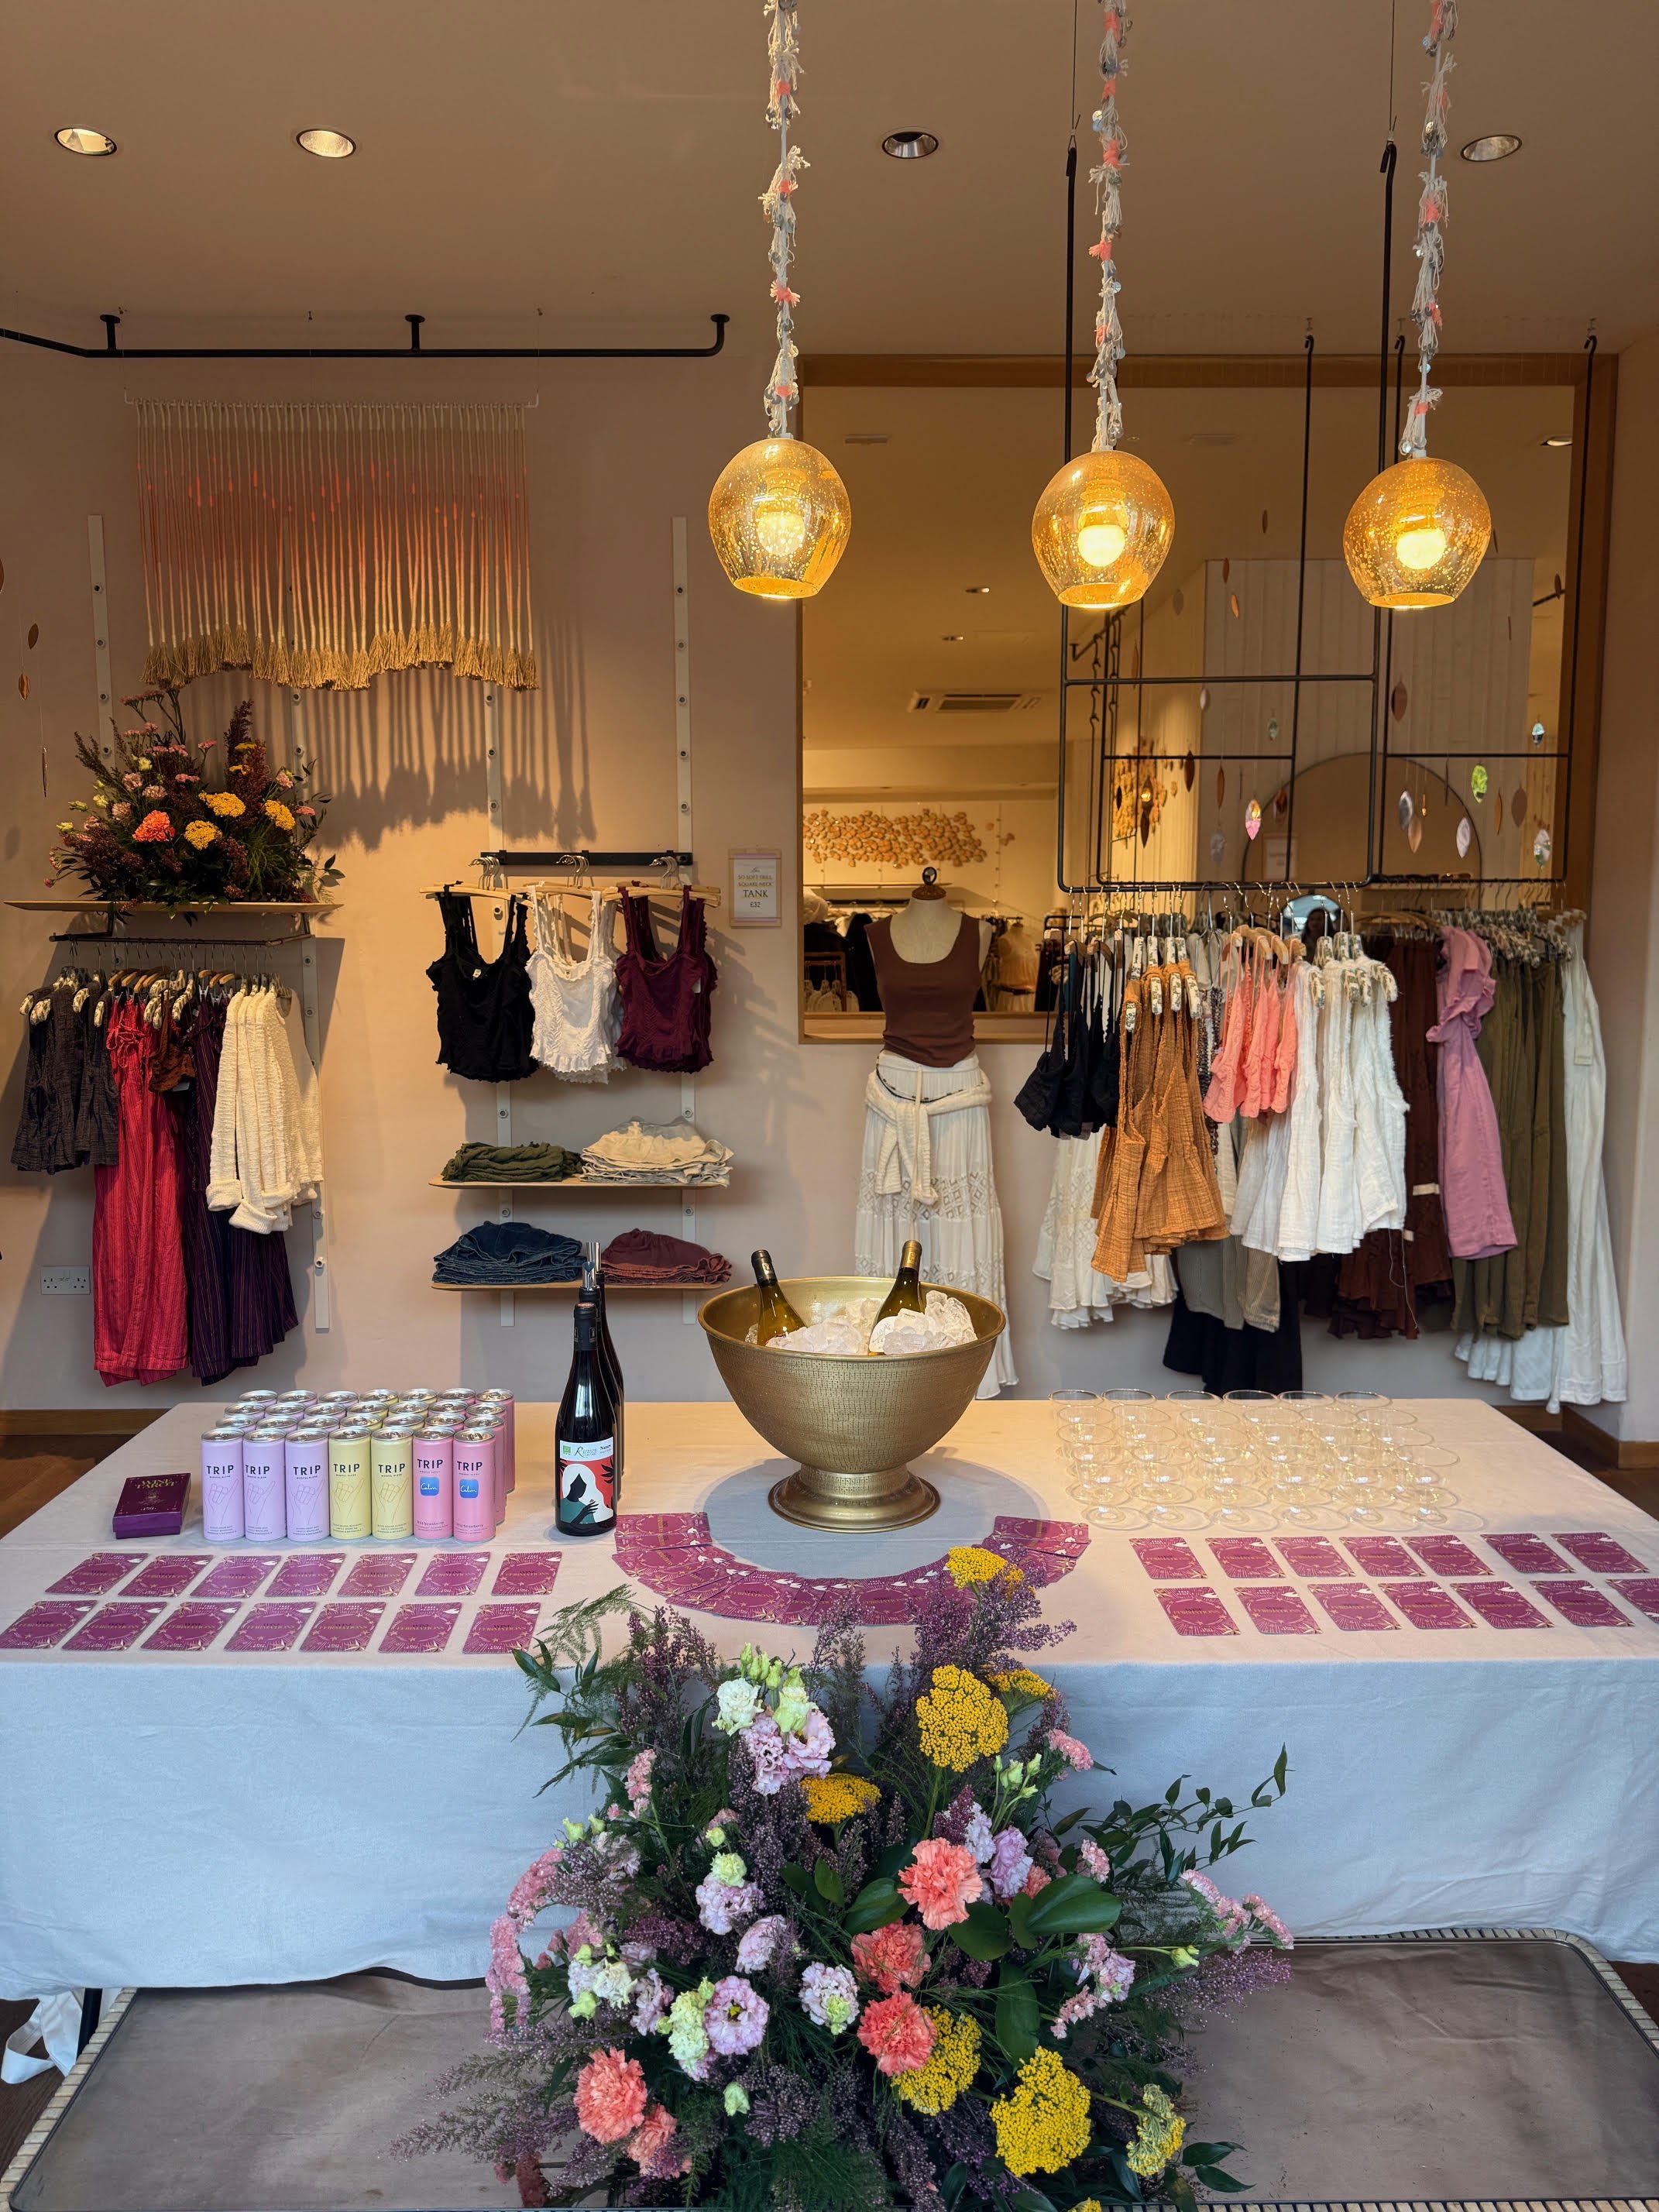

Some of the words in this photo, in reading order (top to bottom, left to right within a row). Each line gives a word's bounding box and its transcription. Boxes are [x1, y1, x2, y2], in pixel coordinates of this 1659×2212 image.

[333, 1463, 360, 1473] TRIP
[378, 1463, 405, 1473] TRIP
[417, 1458, 443, 1468] TRIP
[457, 1461, 483, 1471] TRIP
[206, 1465, 234, 1475] TRIP
[245, 1465, 270, 1475] TRIP
[293, 1465, 321, 1475] TRIP
